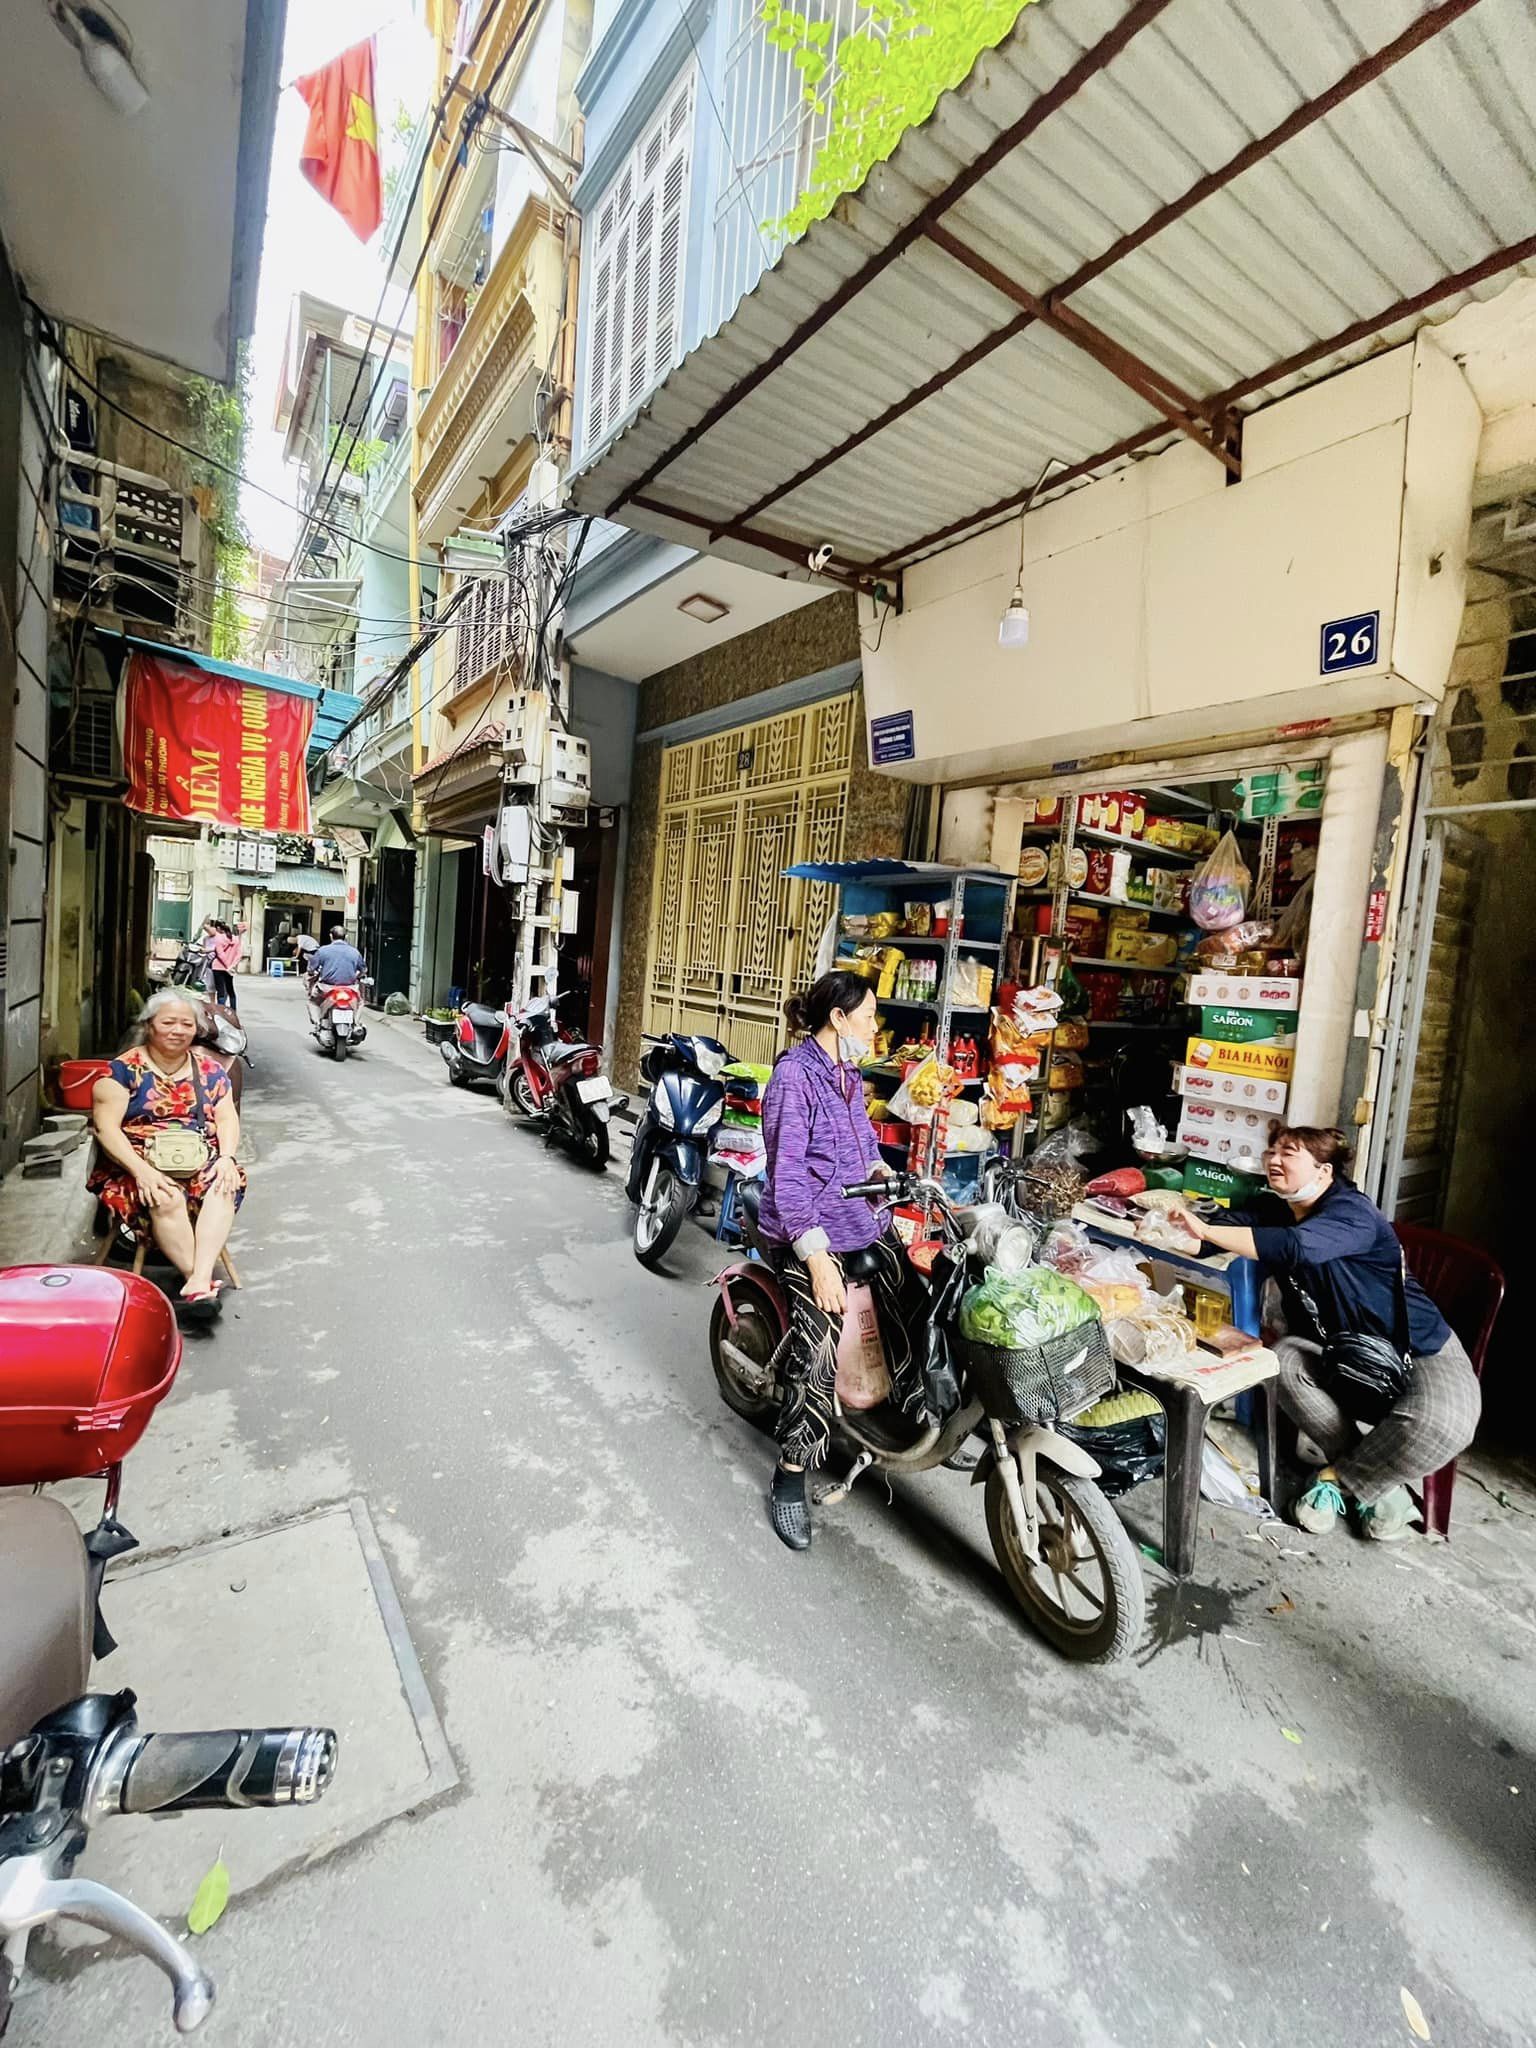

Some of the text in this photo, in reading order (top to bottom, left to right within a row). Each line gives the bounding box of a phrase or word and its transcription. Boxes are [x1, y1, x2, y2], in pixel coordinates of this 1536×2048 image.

[1327, 624, 1372, 662] 26
[236, 687, 270, 730] QUÂN
[241, 731, 273, 752] VỤ
[279, 750, 289, 771] 2020
[738, 752, 750, 768] 28
[235, 755, 267, 801] NGHĨA
[1218, 1048, 1240, 1061] BIA
[1242, 1049, 1262, 1065] HÀ
[1264, 1052, 1289, 1070] NỘI
[1194, 1167, 1234, 1184] SAIGON
